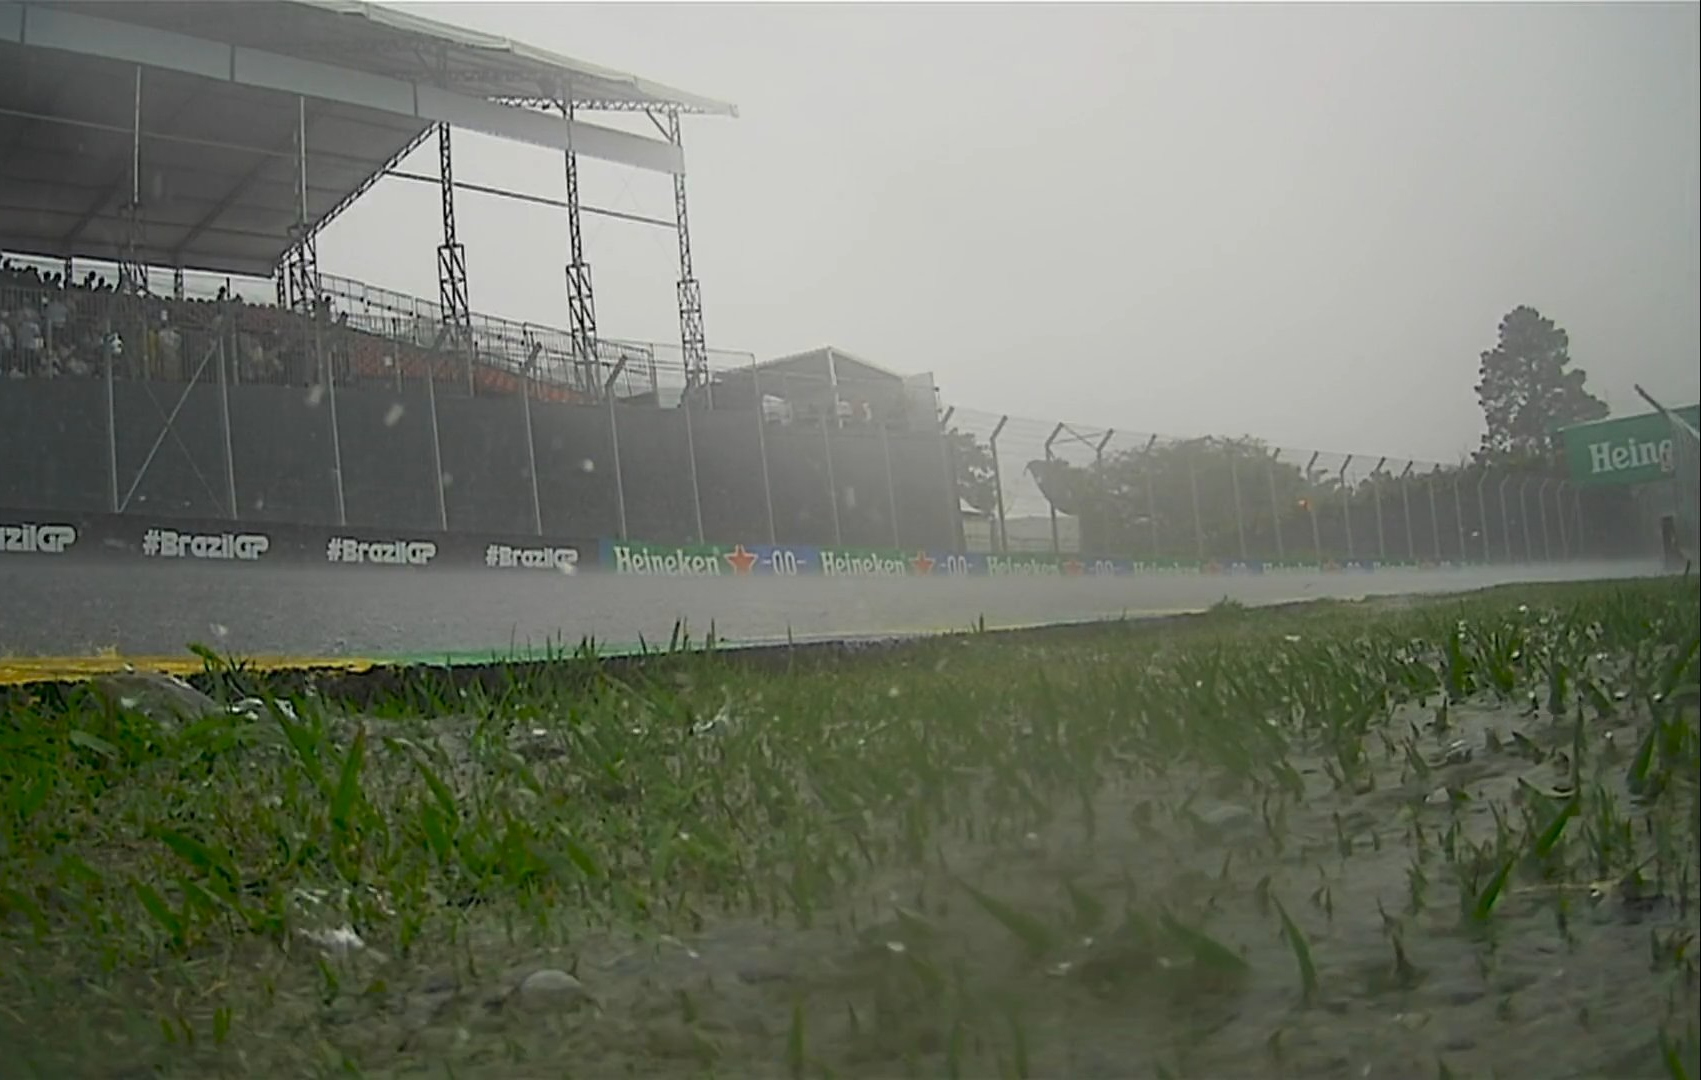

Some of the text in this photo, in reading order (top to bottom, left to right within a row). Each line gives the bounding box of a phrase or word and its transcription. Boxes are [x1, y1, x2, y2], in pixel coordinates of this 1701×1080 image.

[143, 528, 269, 560] #BrazilGP
[327, 538, 437, 565] #BrazilGP
[613, 546, 721, 577] Heineken
[820, 551, 906, 577] Heineken
